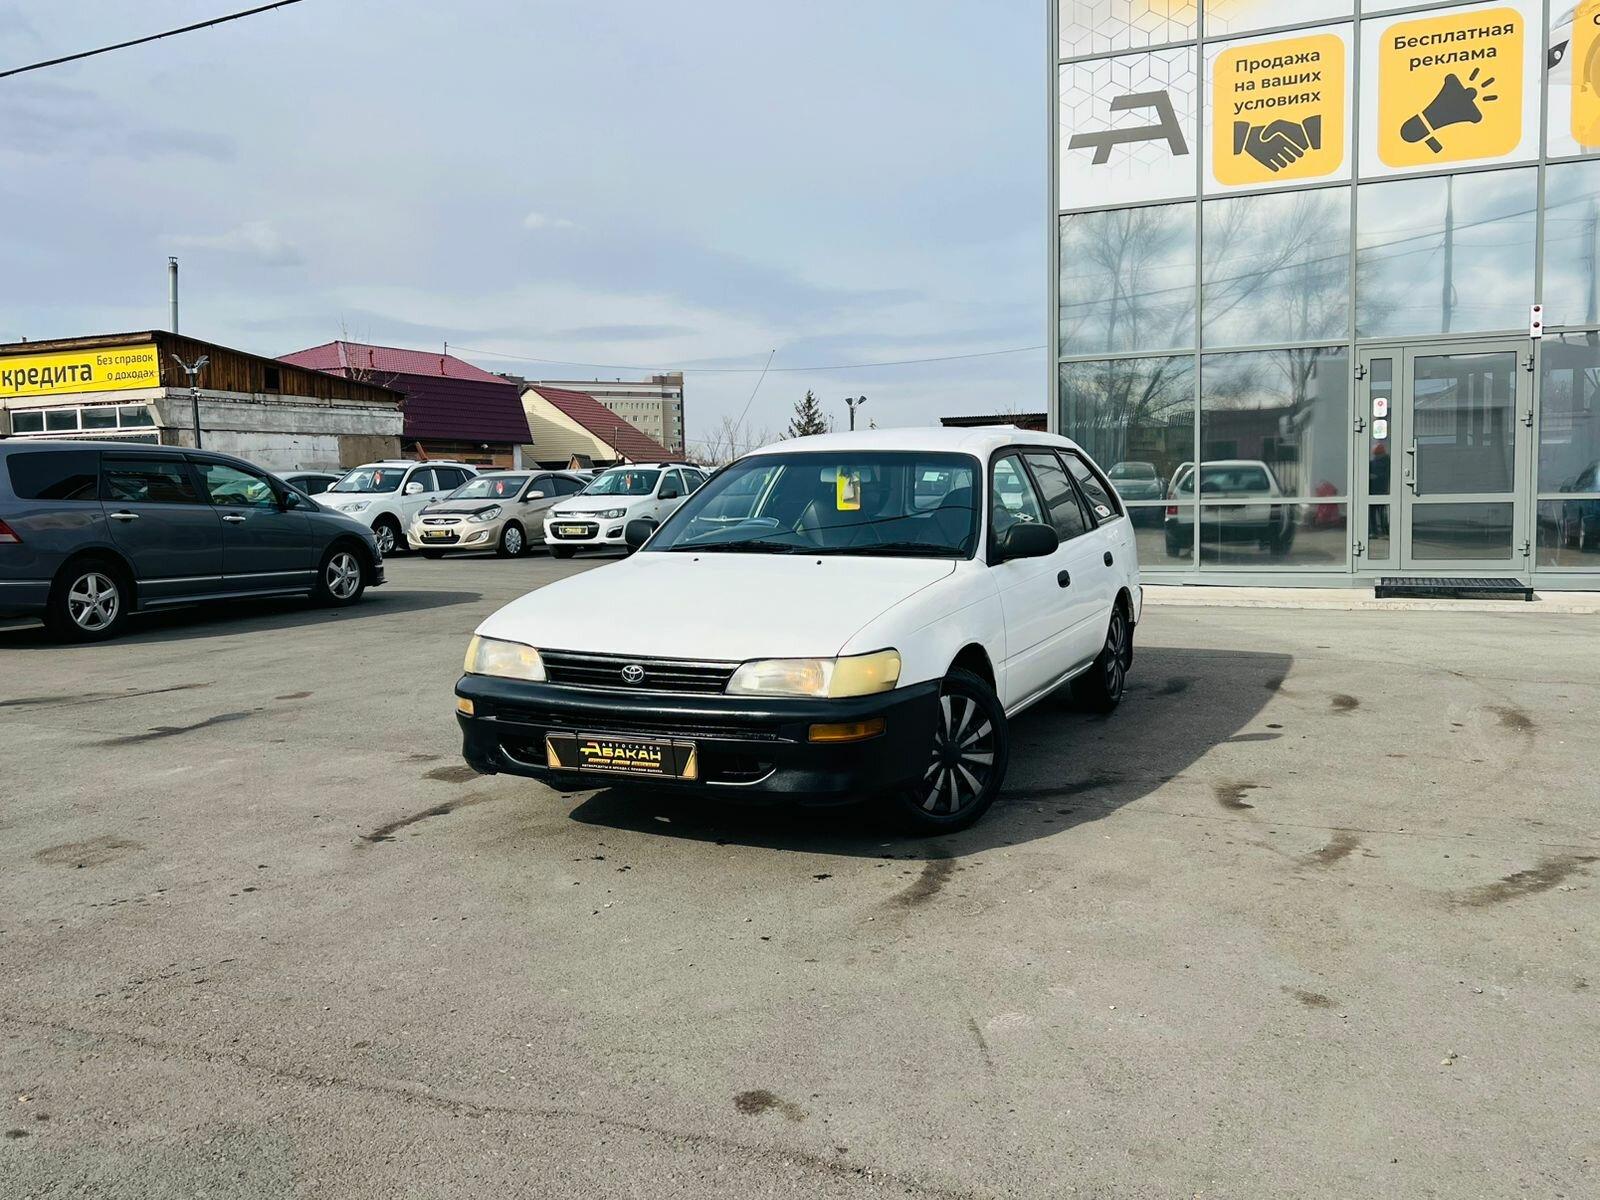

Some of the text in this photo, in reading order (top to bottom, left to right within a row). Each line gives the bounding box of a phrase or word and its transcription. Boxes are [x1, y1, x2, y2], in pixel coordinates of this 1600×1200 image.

[1394, 23, 1515, 50] Бесплатная
[1235, 51, 1321, 73] Продажа
[1409, 47, 1498, 72] реклама
[1234, 71, 1321, 92] на ваших
[1233, 91, 1321, 115] условиях
[97, 354, 153, 367] Без справок
[1, 363, 93, 391] кредита
[107, 370, 155, 380] о доходах
